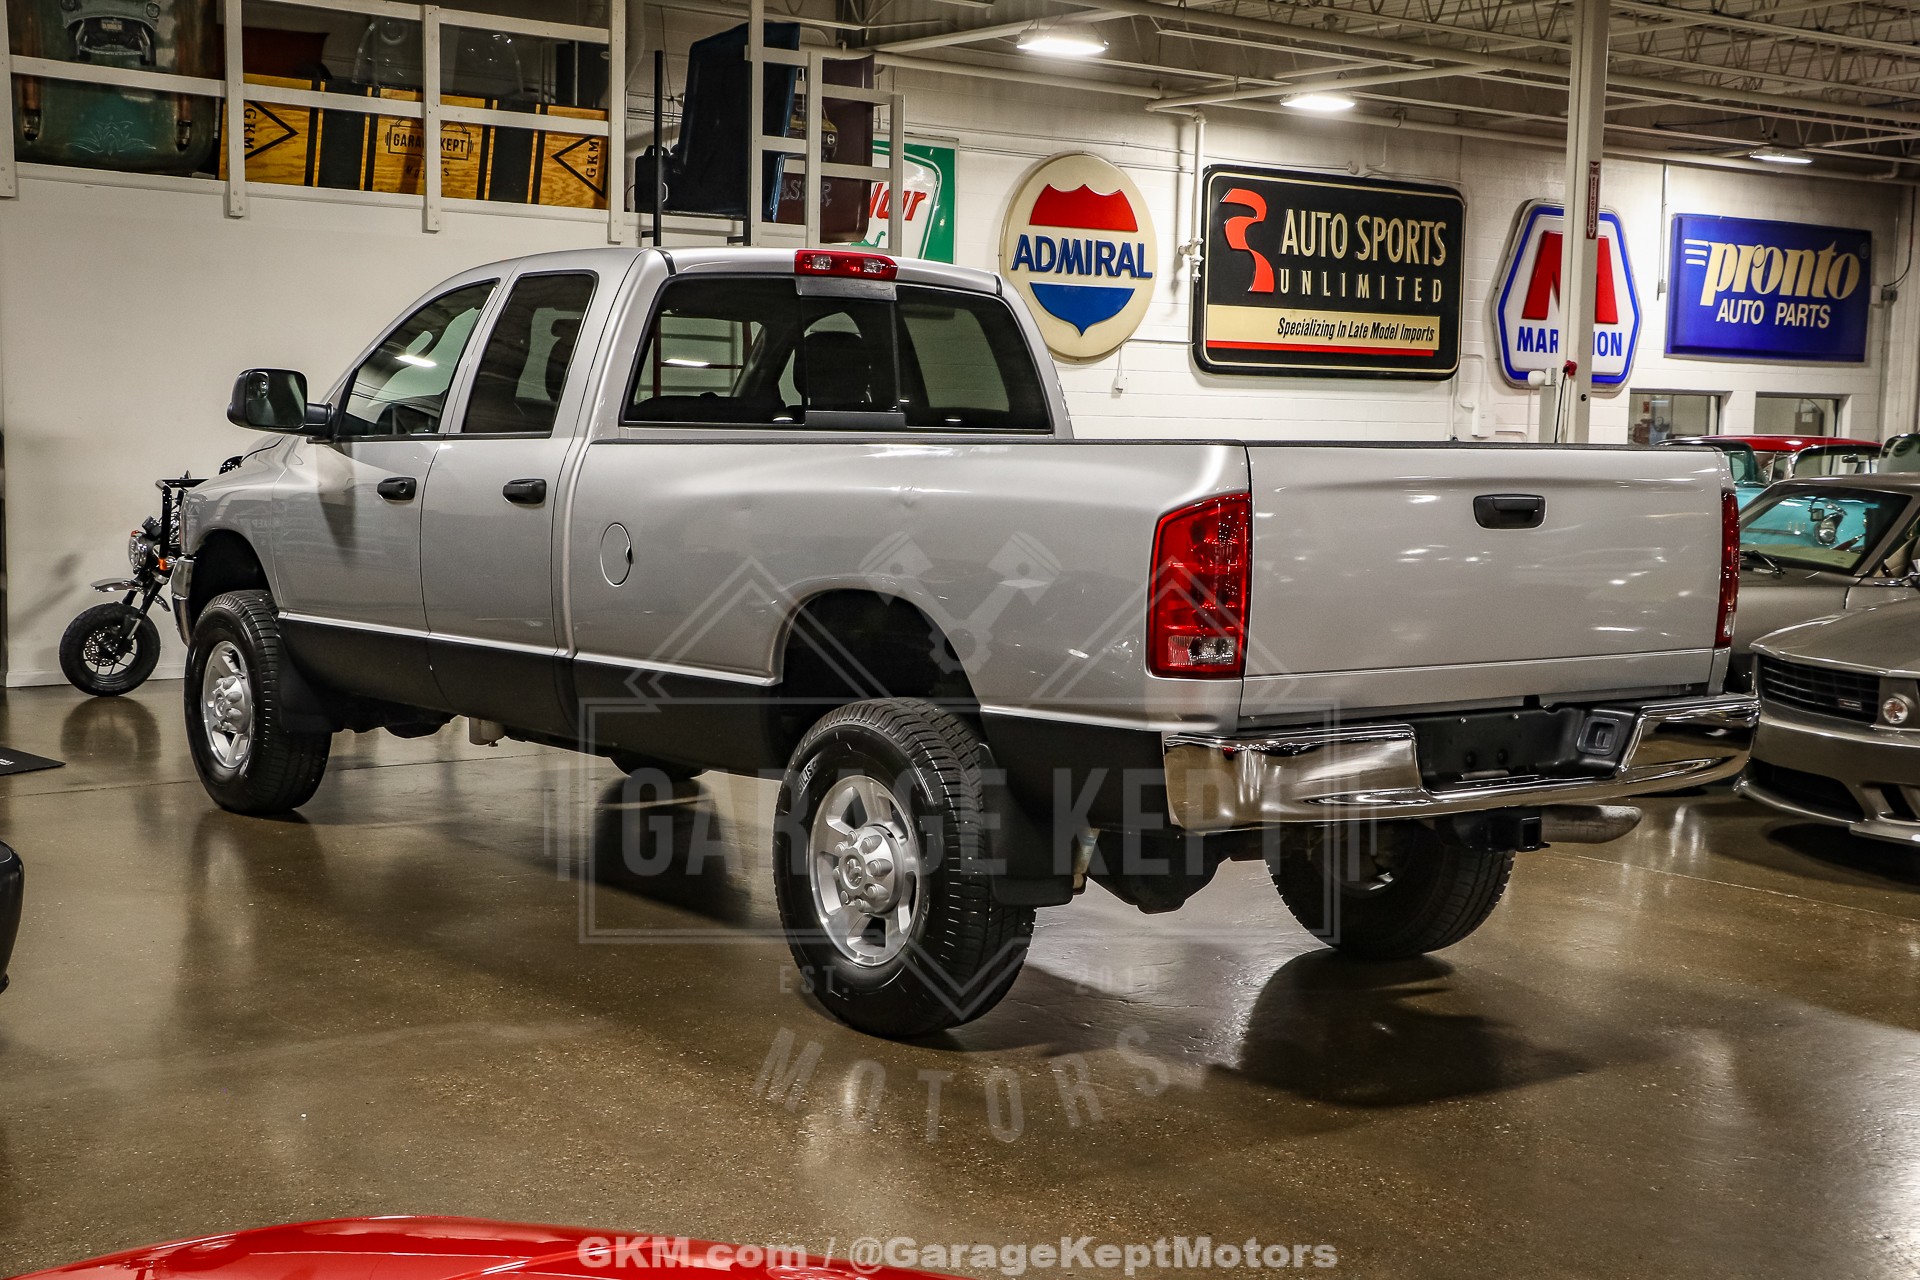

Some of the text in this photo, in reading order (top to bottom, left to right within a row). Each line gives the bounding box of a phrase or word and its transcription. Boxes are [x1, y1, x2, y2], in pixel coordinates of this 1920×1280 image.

[244, 108, 257, 149] GKM
[393, 133, 426, 149] GARA
[586, 141, 600, 178] GKM
[1279, 208, 1447, 267] AUTO SPORTS
[1011, 234, 1153, 279] ADMIRAL
[1700, 240, 1860, 306] pronto
[1280, 267, 1442, 303] UNLIMITED
[1277, 317, 1435, 343] Specializing In Late Model Imports
[1716, 298, 1831, 329] AUTO PARTS
[1516, 325, 1623, 357] MARON
